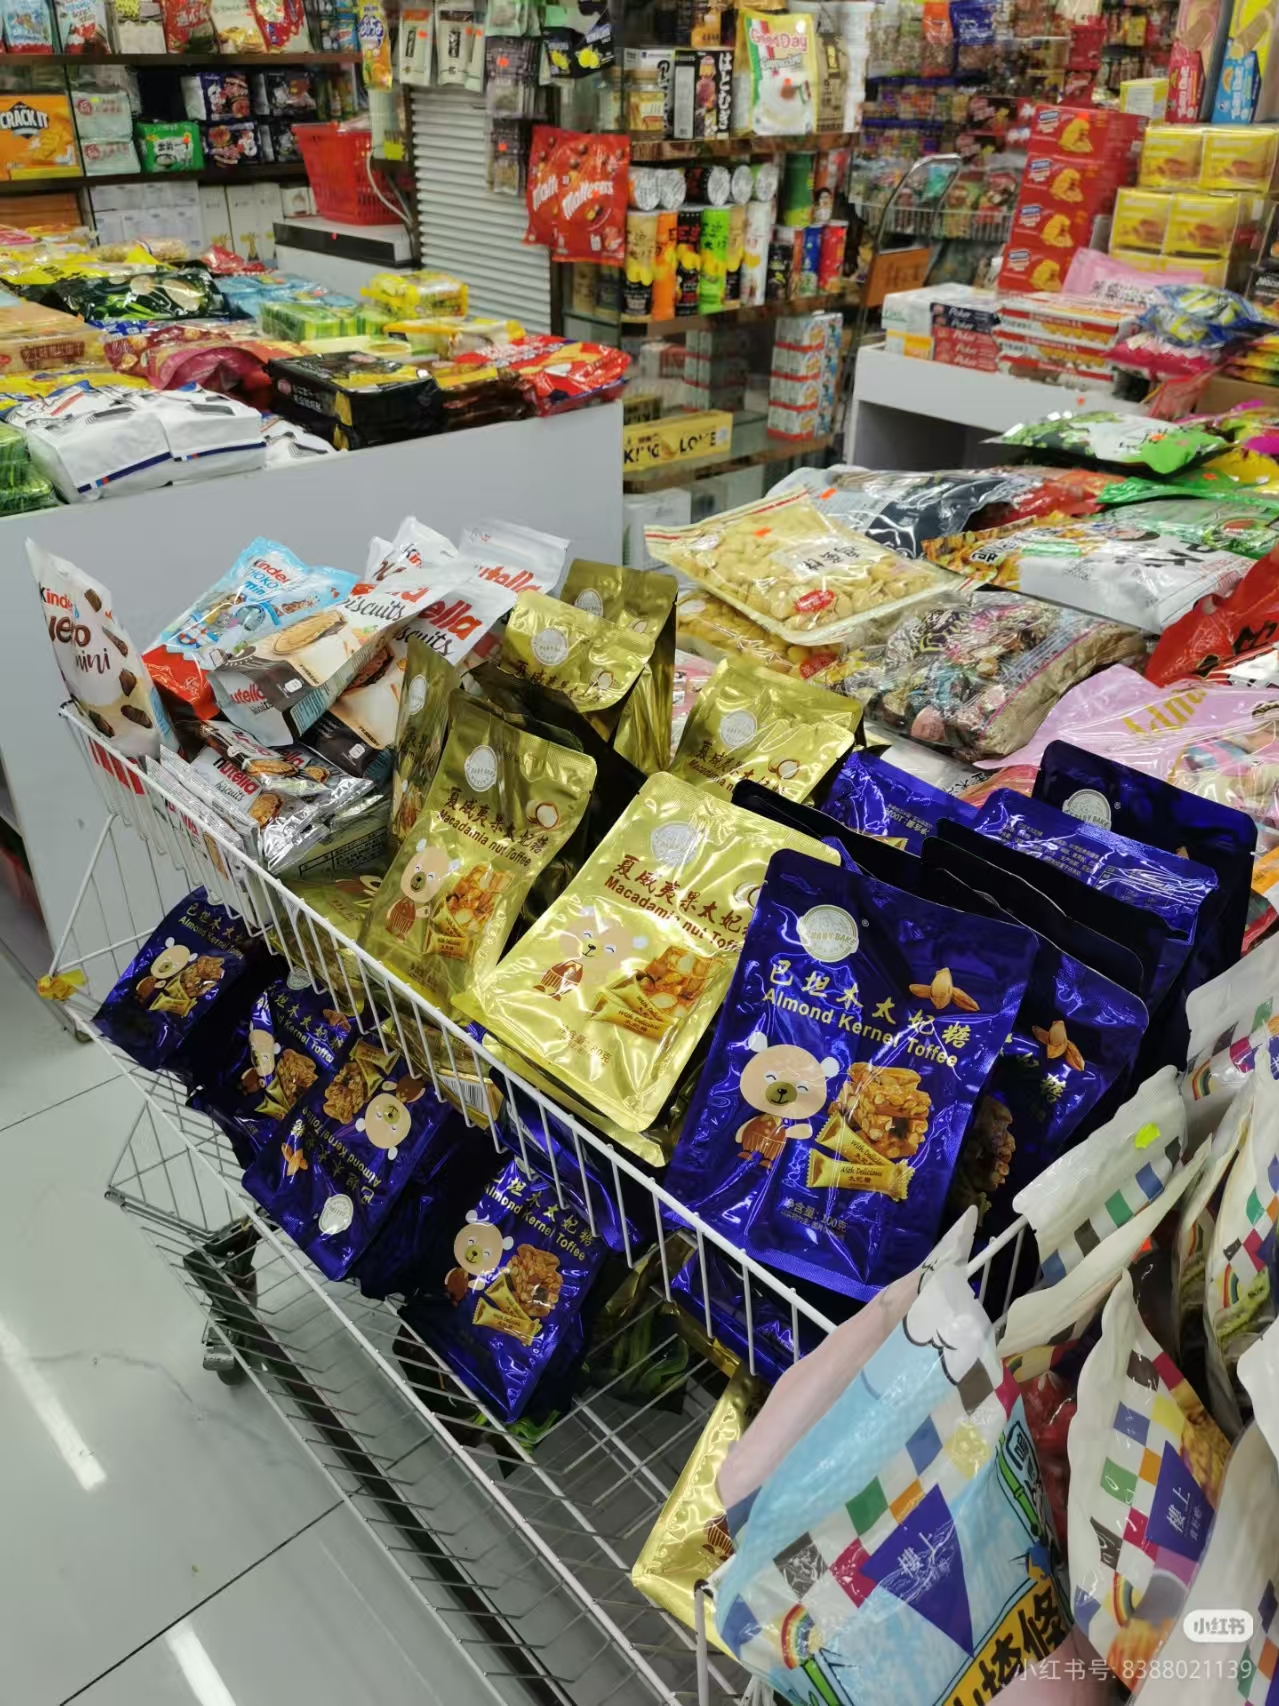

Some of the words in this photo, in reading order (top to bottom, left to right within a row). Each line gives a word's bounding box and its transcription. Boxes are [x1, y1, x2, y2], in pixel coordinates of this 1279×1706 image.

[780, 33, 808, 52] Day
[0, 109, 37, 129] CRACK
[36, 111, 48, 128] IT
[433, 600, 482, 641] ella
[232, 683, 266, 704] utella
[213, 758, 261, 796] nutella
[214, 781, 246, 802] biscuits
[612, 854, 750, 936] 夏威夷果太妃
[769, 959, 972, 1049] 巴坦木太妃糖
[762, 988, 832, 1025] Almond
[838, 1013, 900, 1048] Kernel
[906, 1036, 958, 1068] Toffee
[346, 1154, 382, 1188] Almond
[493, 1175, 597, 1247] 坦木太妃糖
[522, 1210, 556, 1238] Kernel
[555, 1233, 586, 1262] Toffee
